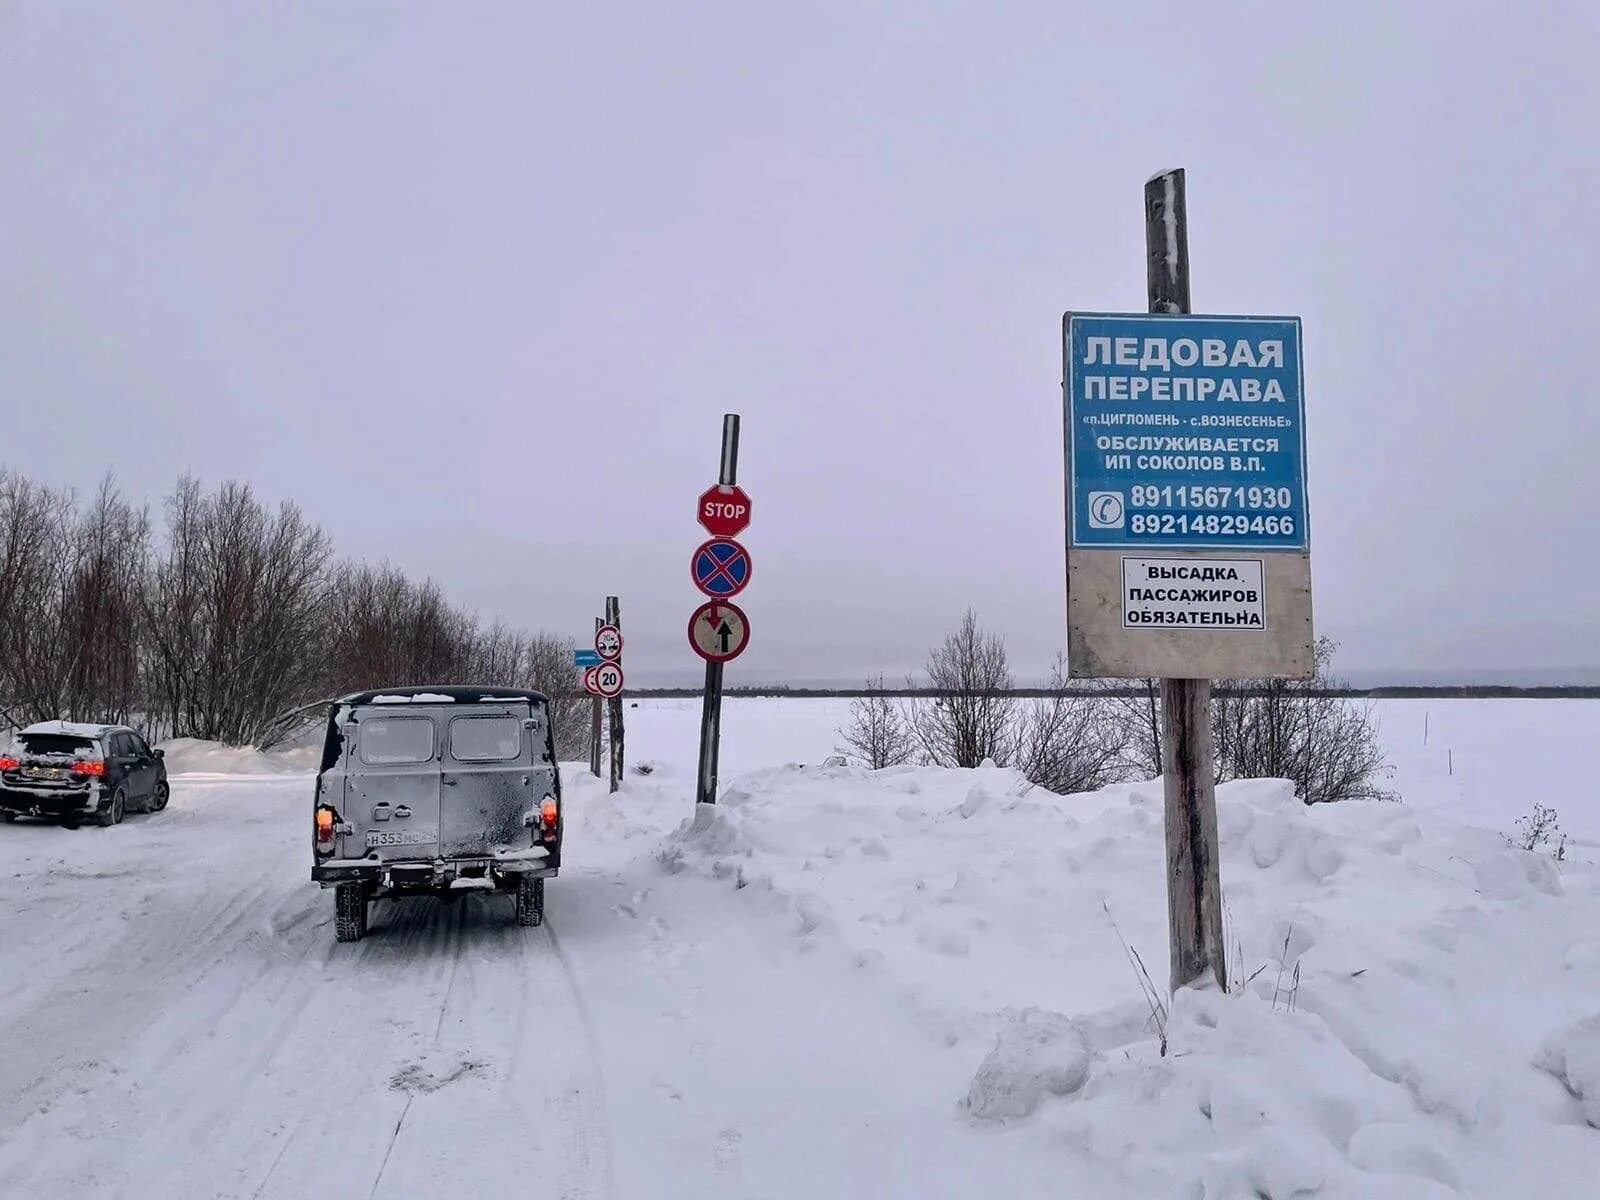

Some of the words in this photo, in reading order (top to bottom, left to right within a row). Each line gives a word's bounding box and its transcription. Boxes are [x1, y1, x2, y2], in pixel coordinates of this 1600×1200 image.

[1084, 336, 1284, 372] ЛЕДОВАЯ
[1083, 375, 1286, 403] ПЕРЕПРАВА
[1096, 435, 1279, 453] ОБСЛУЖИВАЕТСЯ
[1105, 455, 1131, 470] ИП
[1136, 455, 1225, 471] СОКОЛОВ
[1230, 456, 1266, 472] В.П.
[1131, 485, 1292, 509] 89115671930
[704, 501, 746, 519] STOP
[1131, 514, 1295, 535] 89214829466
[1148, 566, 1239, 582] ВЫСАДКА
[1129, 588, 1258, 602] ПАССАЖИРОВ
[1128, 610, 1262, 625] ОБЯЗАТЕЛЬНА
[602, 672, 617, 686] 20
